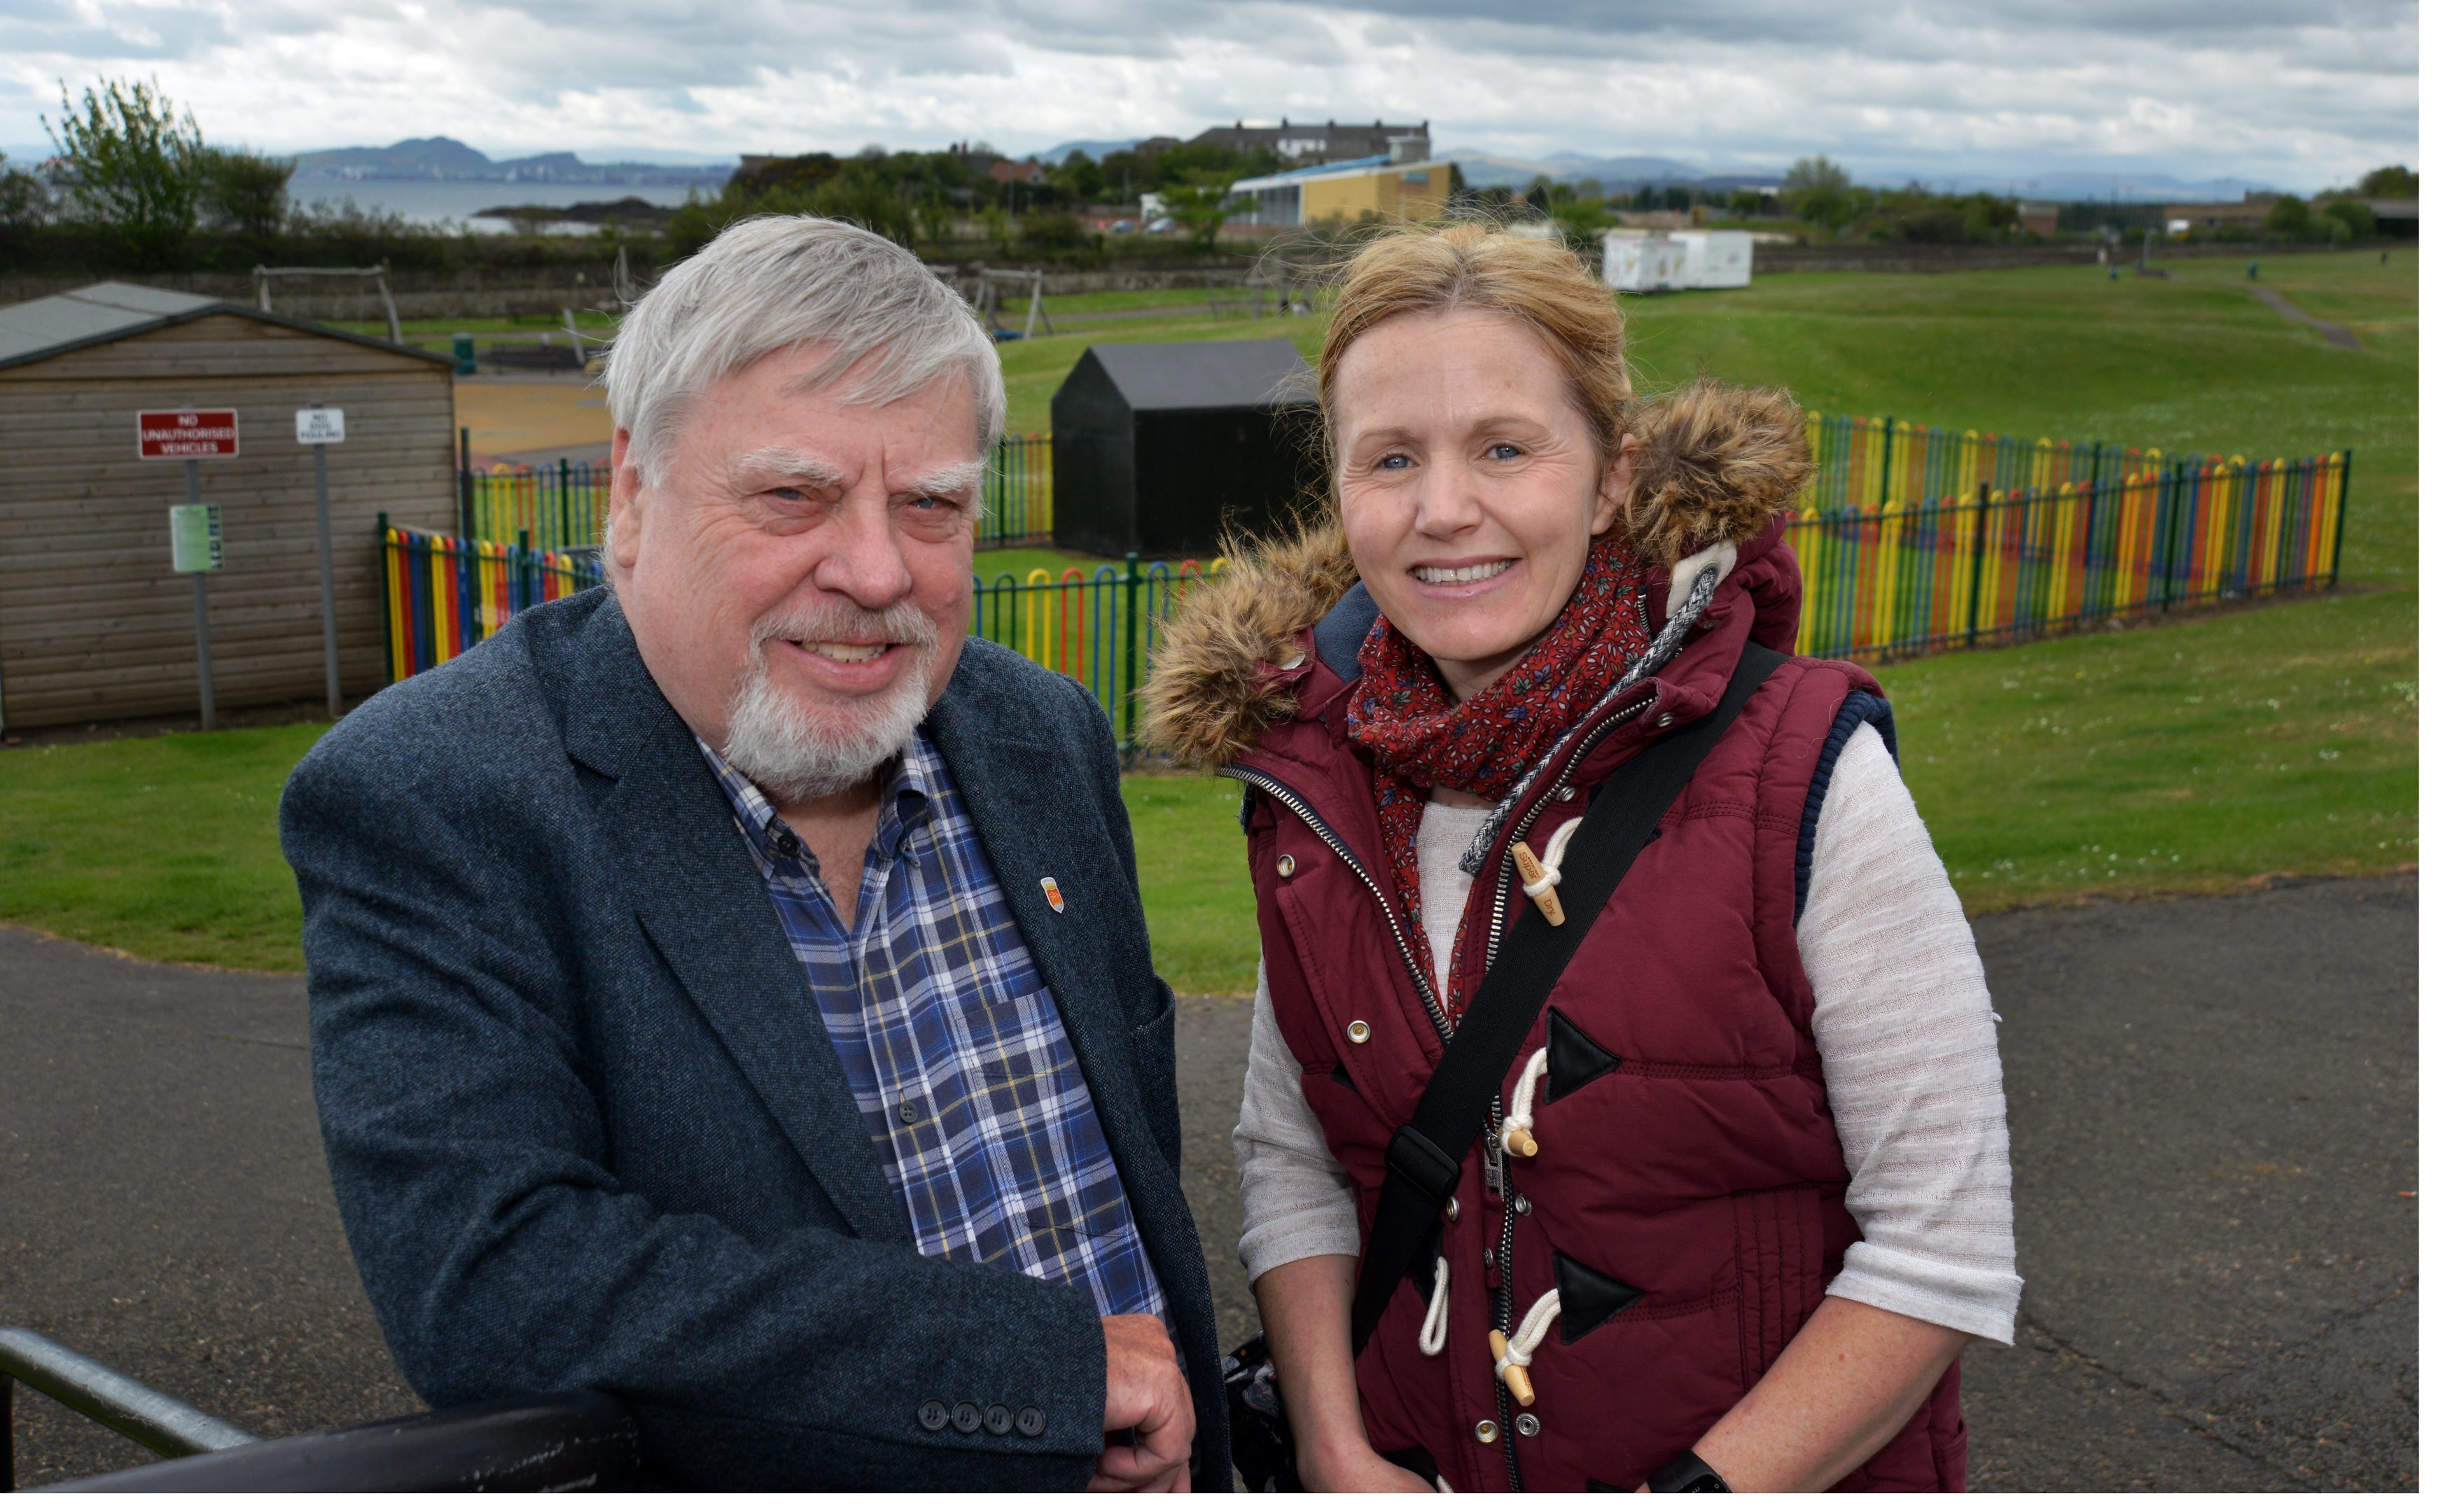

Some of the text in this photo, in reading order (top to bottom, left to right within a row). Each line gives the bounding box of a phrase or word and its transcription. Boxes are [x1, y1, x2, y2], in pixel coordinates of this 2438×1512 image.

[178, 414, 198, 426] NO
[143, 428, 235, 441] UNAUTHORISED
[160, 442, 218, 455] VEHICLES
[1519, 852, 1538, 879] Super
